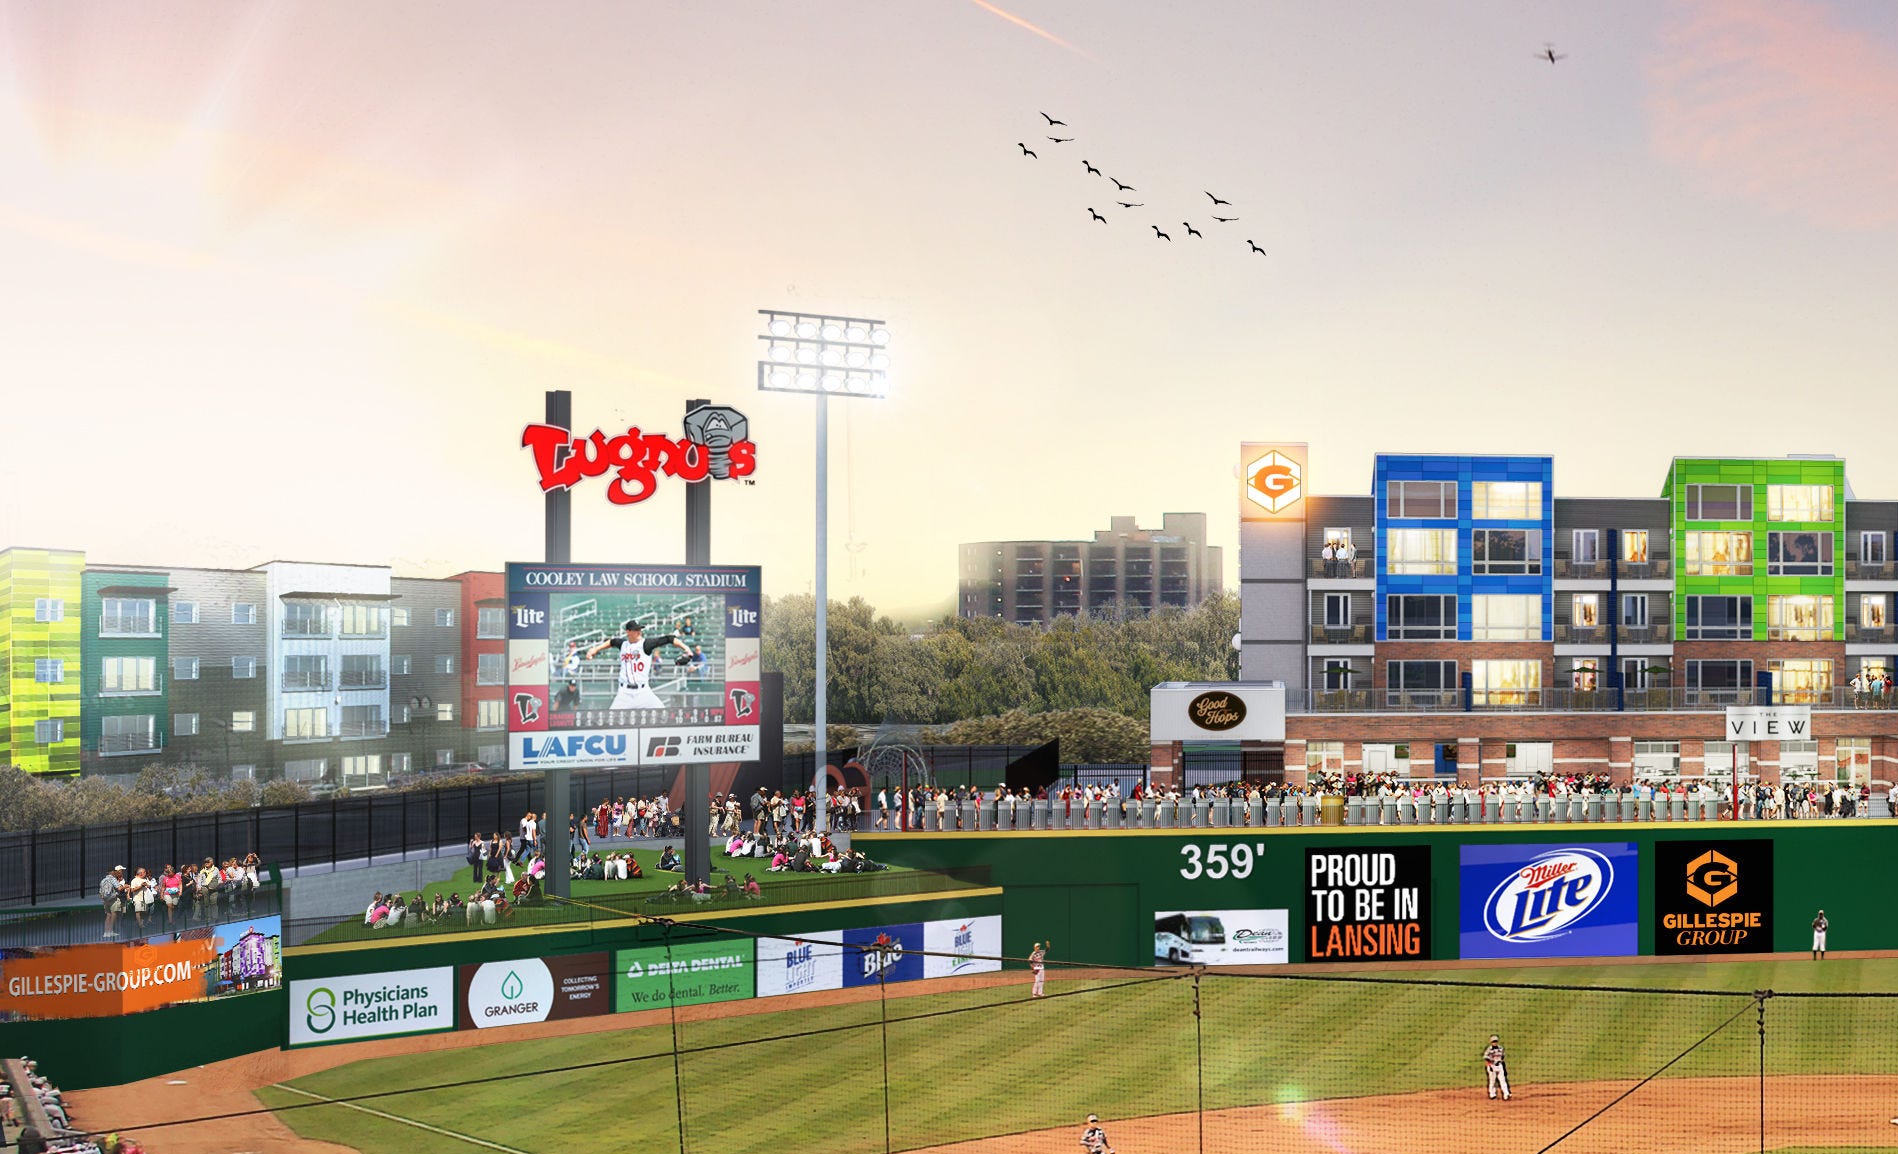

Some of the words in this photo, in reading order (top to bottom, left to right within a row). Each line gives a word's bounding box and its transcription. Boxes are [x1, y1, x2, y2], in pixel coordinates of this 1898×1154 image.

[525, 572, 585, 586] COOLEY
[590, 573, 618, 587] LAW
[624, 573, 682, 587] SCHOOL
[685, 574, 747, 588] STADIUM
[516, 606, 545, 628] Lite
[731, 608, 758, 628] Lite
[633, 661, 645, 673] 10
[1196, 696, 1228, 716] Good
[1205, 710, 1239, 724] Hops
[1732, 719, 1806, 735] VIEW
[523, 734, 627, 758] LAFCU
[686, 735, 712, 745] FARM
[715, 733, 754, 744] BUREAU
[693, 745, 748, 756] INSURANCE
[1179, 843, 1265, 880] 359'
[1311, 853, 1396, 888] PROUD
[1519, 861, 1578, 889] Miller
[1311, 888, 1345, 922] TO
[1355, 888, 1385, 921] BE
[1394, 887, 1419, 920] IN
[1507, 873, 1594, 937] Lite
[1663, 912, 1762, 929] GILLESPIE
[954, 930, 972, 948] BLUE
[1311, 922, 1421, 958] LANSING
[1676, 929, 1747, 946] GROUP
[648, 961, 688, 977] DELTA
[690, 955, 743, 973] DENTAL
[786, 944, 812, 968] BLUE
[8, 960, 193, 997] GILLESPIE-GROUP.COM
[563, 975, 598, 985] COLLECTING
[343, 984, 428, 1007] Physicians
[569, 991, 592, 1000] ENERGY
[631, 991, 649, 1003] We
[652, 990, 666, 1002] do
[669, 986, 705, 1001] dental.
[709, 983, 740, 997] Better.
[343, 1007, 401, 1026] Health
[405, 1003, 438, 1020] Plan
[484, 1002, 538, 1018] GRANGER
